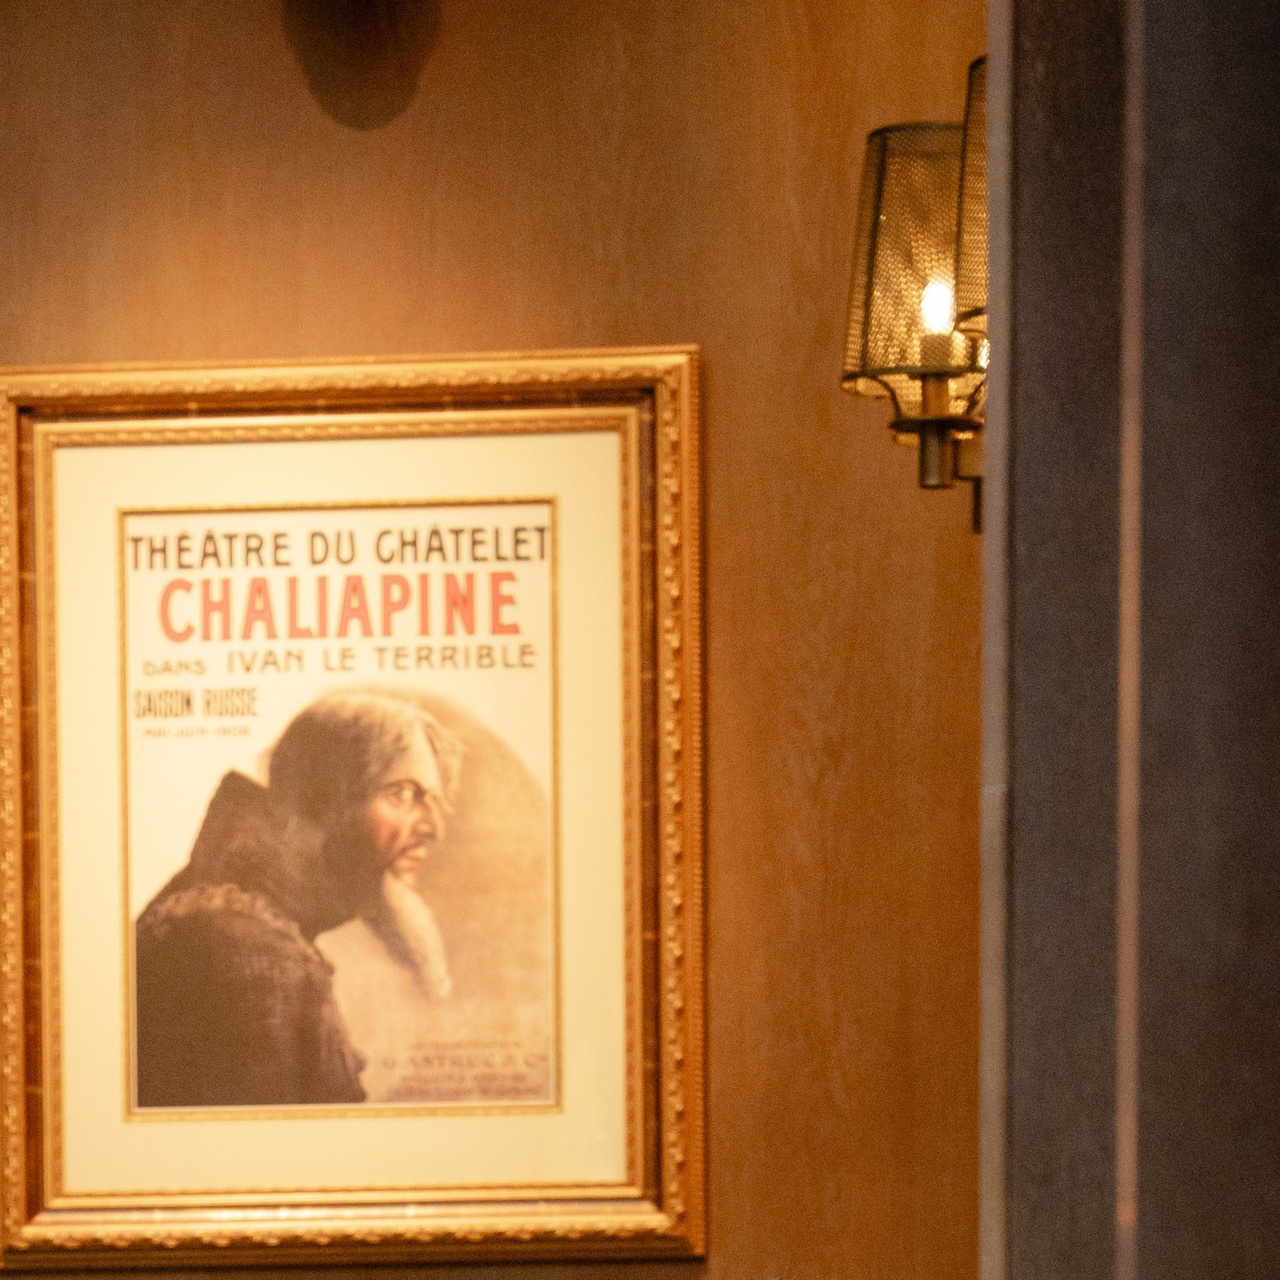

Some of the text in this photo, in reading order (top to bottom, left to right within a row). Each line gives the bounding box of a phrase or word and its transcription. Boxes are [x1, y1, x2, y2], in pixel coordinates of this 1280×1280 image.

[309, 529, 356, 565] DU
[158, 571, 521, 644] CHALIAPINE
[142, 643, 538, 677] DANS IVAN LE TERRIBLE
